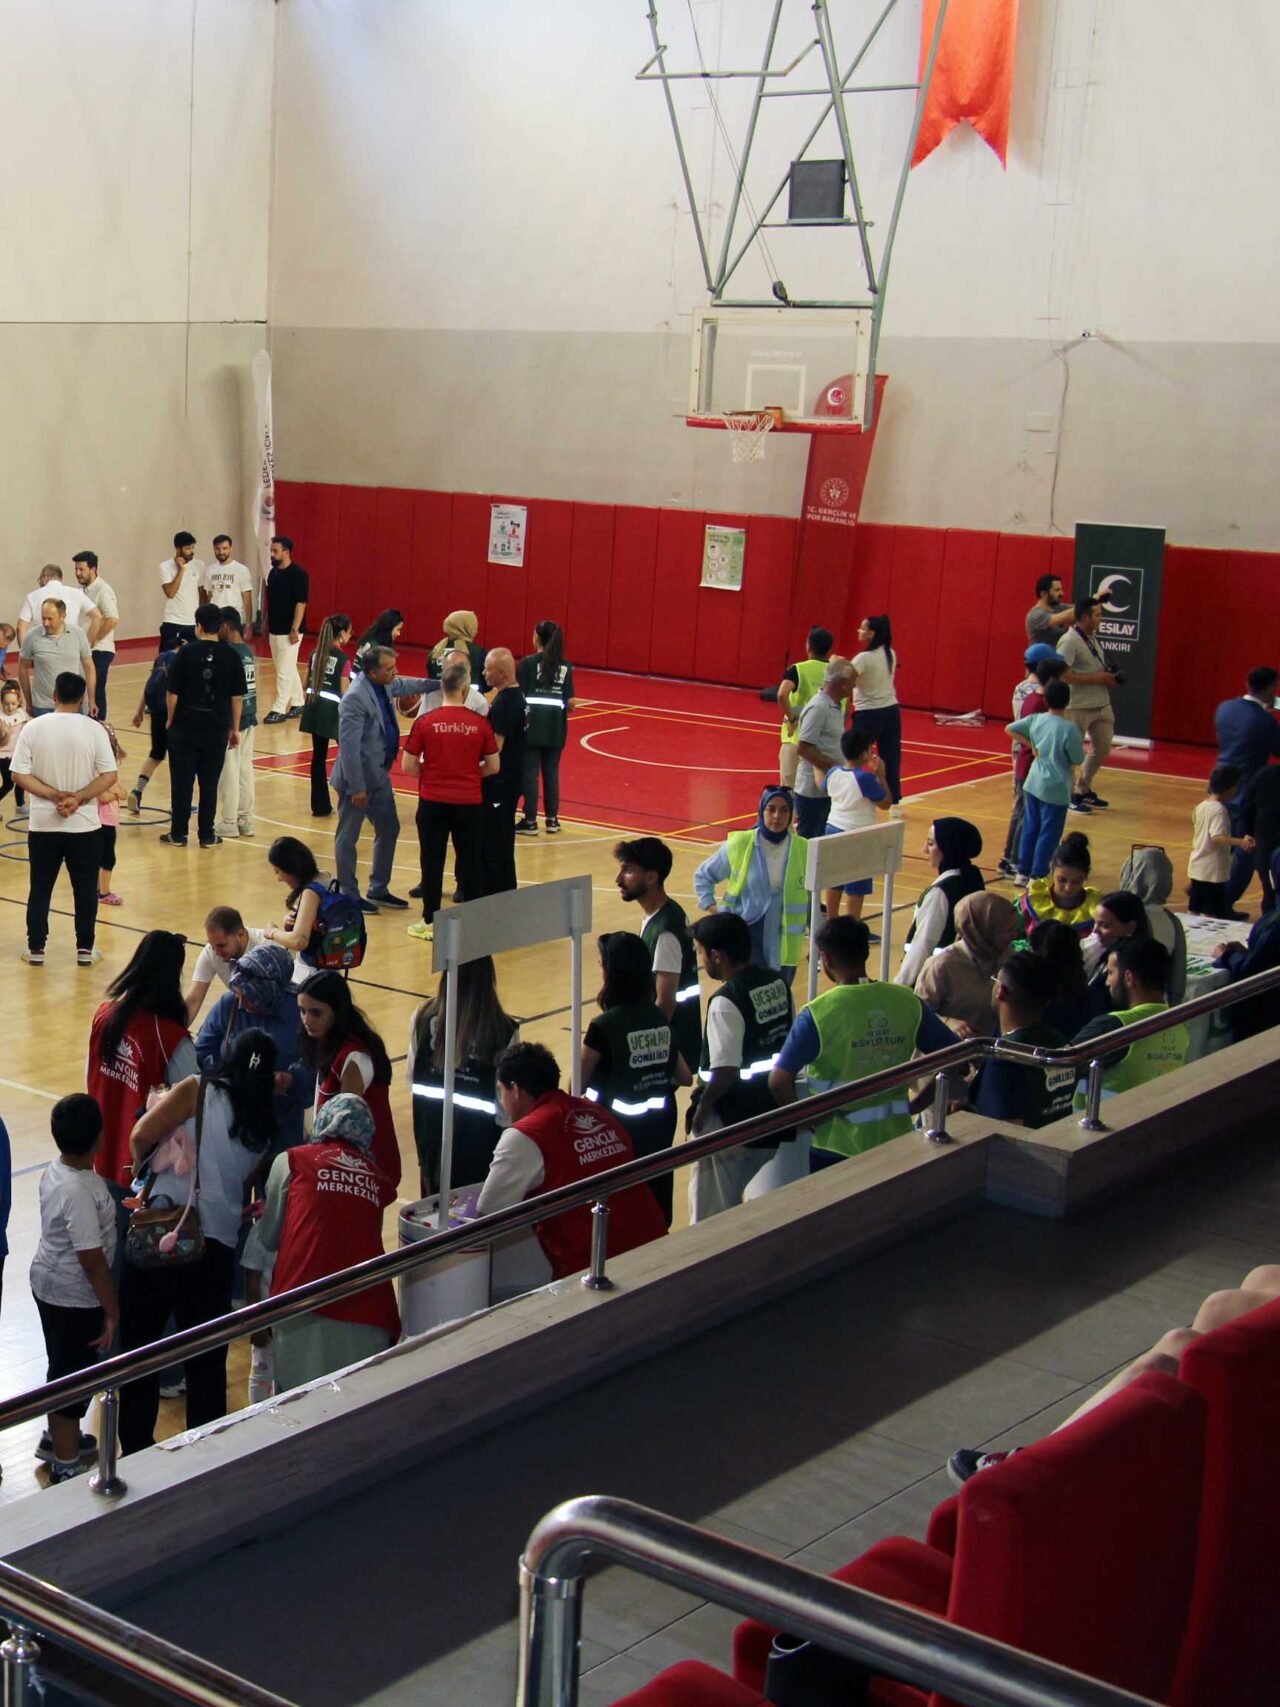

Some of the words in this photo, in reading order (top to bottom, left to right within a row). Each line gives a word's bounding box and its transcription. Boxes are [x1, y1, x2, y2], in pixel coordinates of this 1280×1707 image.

[807, 513, 821, 521] POR
[1099, 622, 1135, 636] EŞİLAY
[1100, 641, 1131, 653] ANKIRI
[432, 722, 478, 736] Türkiye
